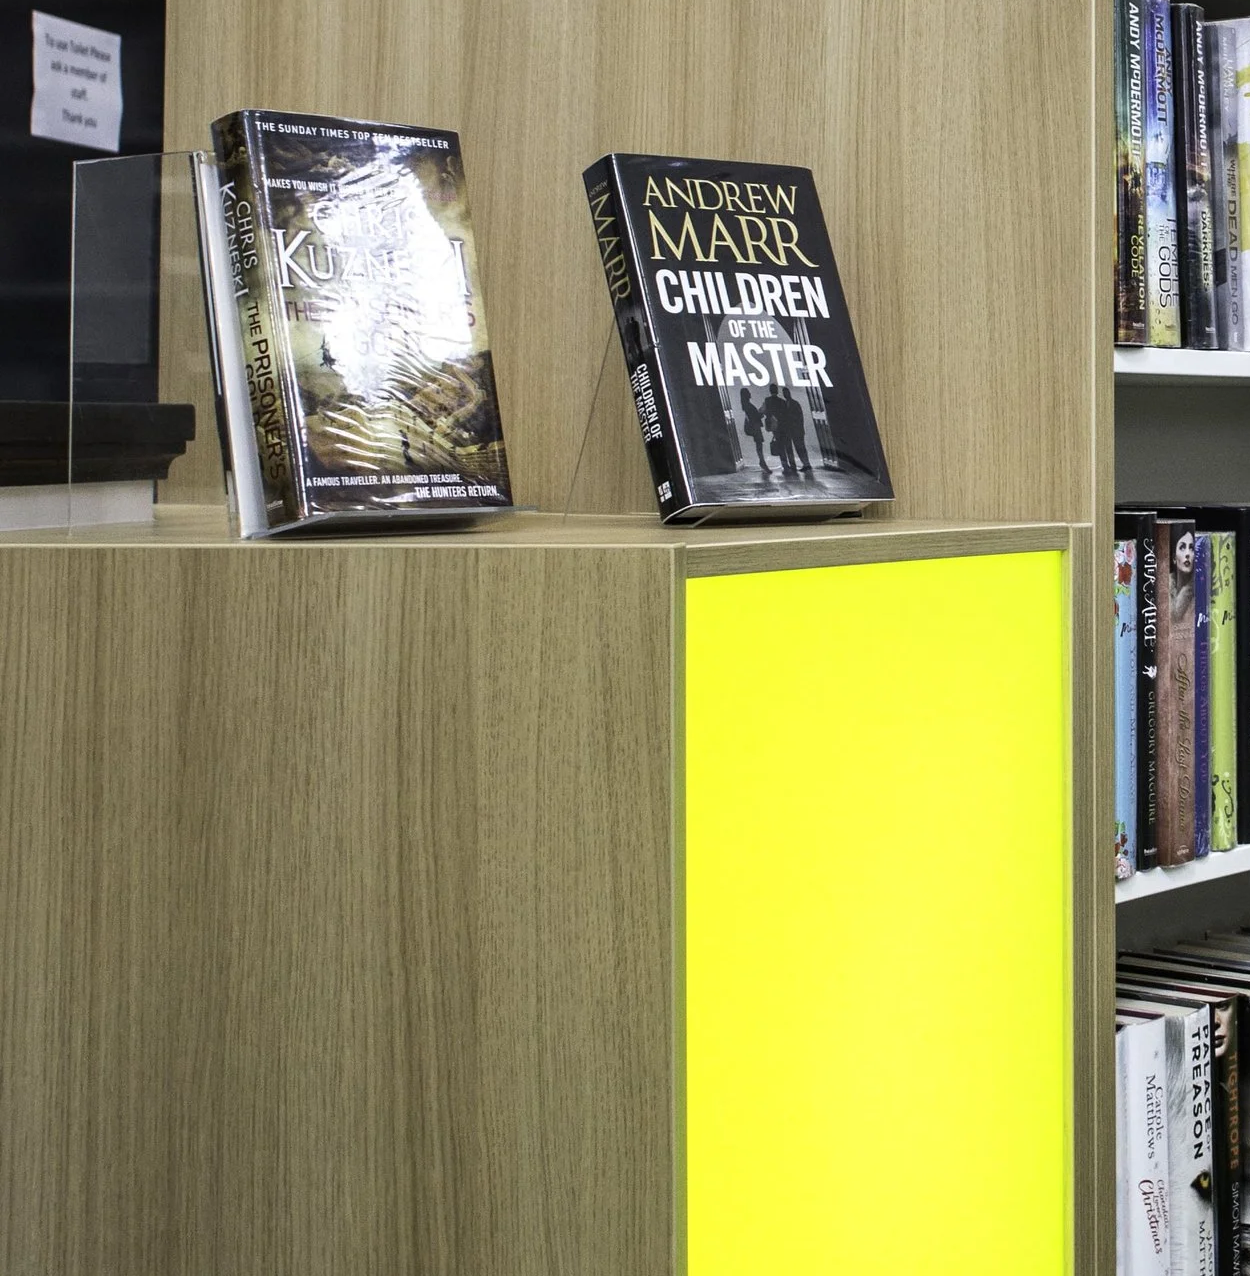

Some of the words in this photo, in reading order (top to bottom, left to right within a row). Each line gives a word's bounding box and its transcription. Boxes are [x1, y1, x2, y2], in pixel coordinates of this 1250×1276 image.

[255, 121, 276, 132] THE
[278, 123, 317, 136] SUNDAY
[320, 126, 350, 139] TIMES
[352, 130, 370, 141] TOP
[372, 132, 391, 144] TEN
[392, 135, 449, 150] BESTSELLER
[292, 179, 307, 191] YOU
[308, 180, 329, 192] WISH
[643, 175, 797, 215] ANDREW
[219, 181, 249, 299] KUZNESKI
[236, 200, 257, 270] CHRIS
[271, 228, 471, 300] KUZNEI
[590, 193, 632, 305] MARR
[649, 210, 820, 268] MARR
[655, 269, 830, 318] CHILDREN
[1159, 246, 1171, 307] GODS
[246, 301, 262, 336] THE
[728, 319, 745, 338] OF
[748, 320, 778, 340] THE
[687, 342, 834, 388] MASTER
[253, 340, 287, 479] PRISONER'S
[630, 373, 641, 396] THE
[636, 394, 652, 445] MASTER
[636, 363, 659, 423] CHILDREN
[651, 423, 663, 440] OF
[306, 476, 313, 487] A
[313, 475, 341, 487] FAMOUS
[341, 474, 380, 486] TRAVELLER.
[381, 474, 391, 485] AN
[392, 473, 429, 485] ABANDONED
[429, 473, 463, 484] TREASURE.
[415, 486, 431, 499] THE
[432, 486, 467, 498] HUNTERS
[467, 485, 500, 497] RETURN.
[1148, 692, 1157, 754] GREGORY
[1149, 761, 1157, 825] MAGUIRE
[1154, 1086, 1163, 1140] Carole
[1192, 1030, 1202, 1160] TREASON
